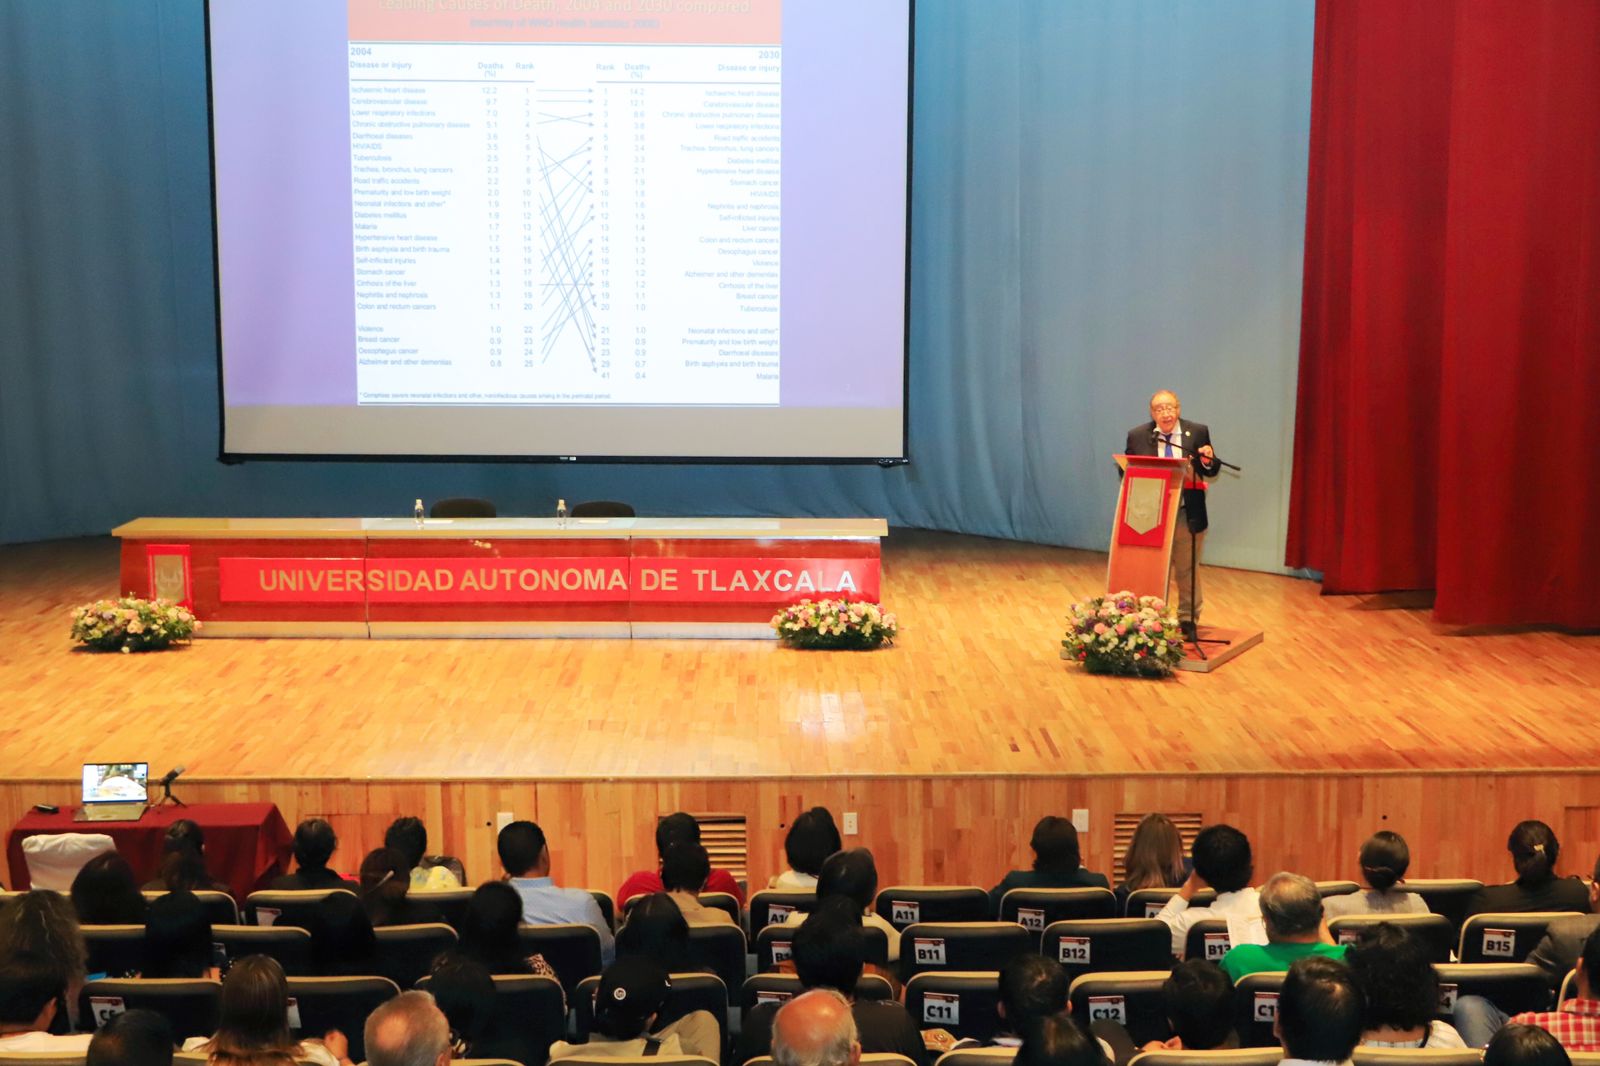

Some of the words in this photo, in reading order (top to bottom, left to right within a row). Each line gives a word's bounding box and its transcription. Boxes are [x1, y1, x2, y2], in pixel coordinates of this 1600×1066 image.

[607, 0, 632, 11] and
[677, 0, 751, 15] compared
[350, 47, 372, 57] 2004
[758, 50, 780, 60] 2030
[350, 61, 379, 69] Disease
[478, 62, 504, 70] Deaths
[515, 62, 535, 70] Rank
[596, 63, 615, 71] Rank
[624, 63, 650, 71] Deaths
[718, 64, 747, 72] Disease
[259, 569, 453, 592] UNIVERSIDAD
[460, 568, 628, 591] AUTONOMA
[641, 569, 678, 591] DE
[692, 569, 857, 592] TLAXCALA
[771, 914, 787, 923] A1
[895, 909, 915, 920] A11
[1020, 917, 1041, 928] A12
[1486, 940, 1510, 952] B15
[918, 949, 940, 960] B11
[1062, 948, 1086, 959] B12
[927, 1005, 951, 1018] C11
[1092, 1008, 1120, 1020] C12
